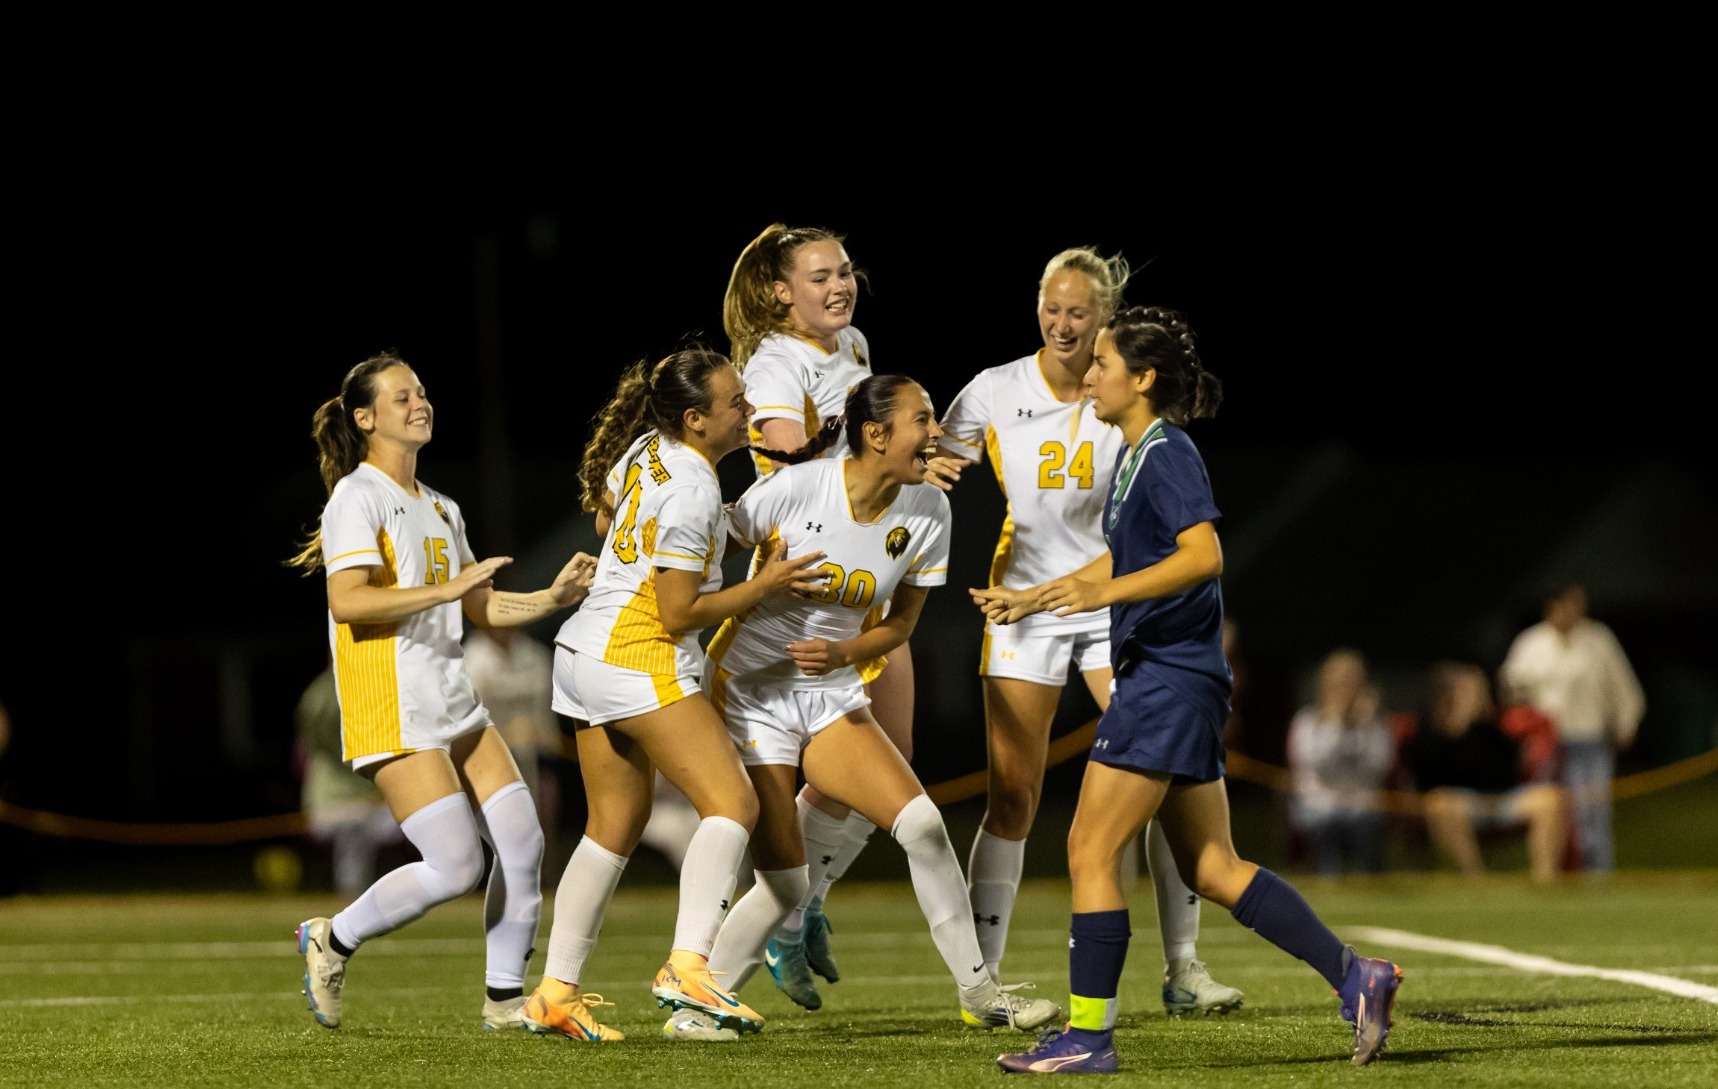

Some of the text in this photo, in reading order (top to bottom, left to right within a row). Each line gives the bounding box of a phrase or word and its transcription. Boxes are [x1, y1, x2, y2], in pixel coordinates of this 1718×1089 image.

[1038, 440, 1095, 490] 24
[423, 536, 450, 585] 15
[809, 561, 877, 609] 30
